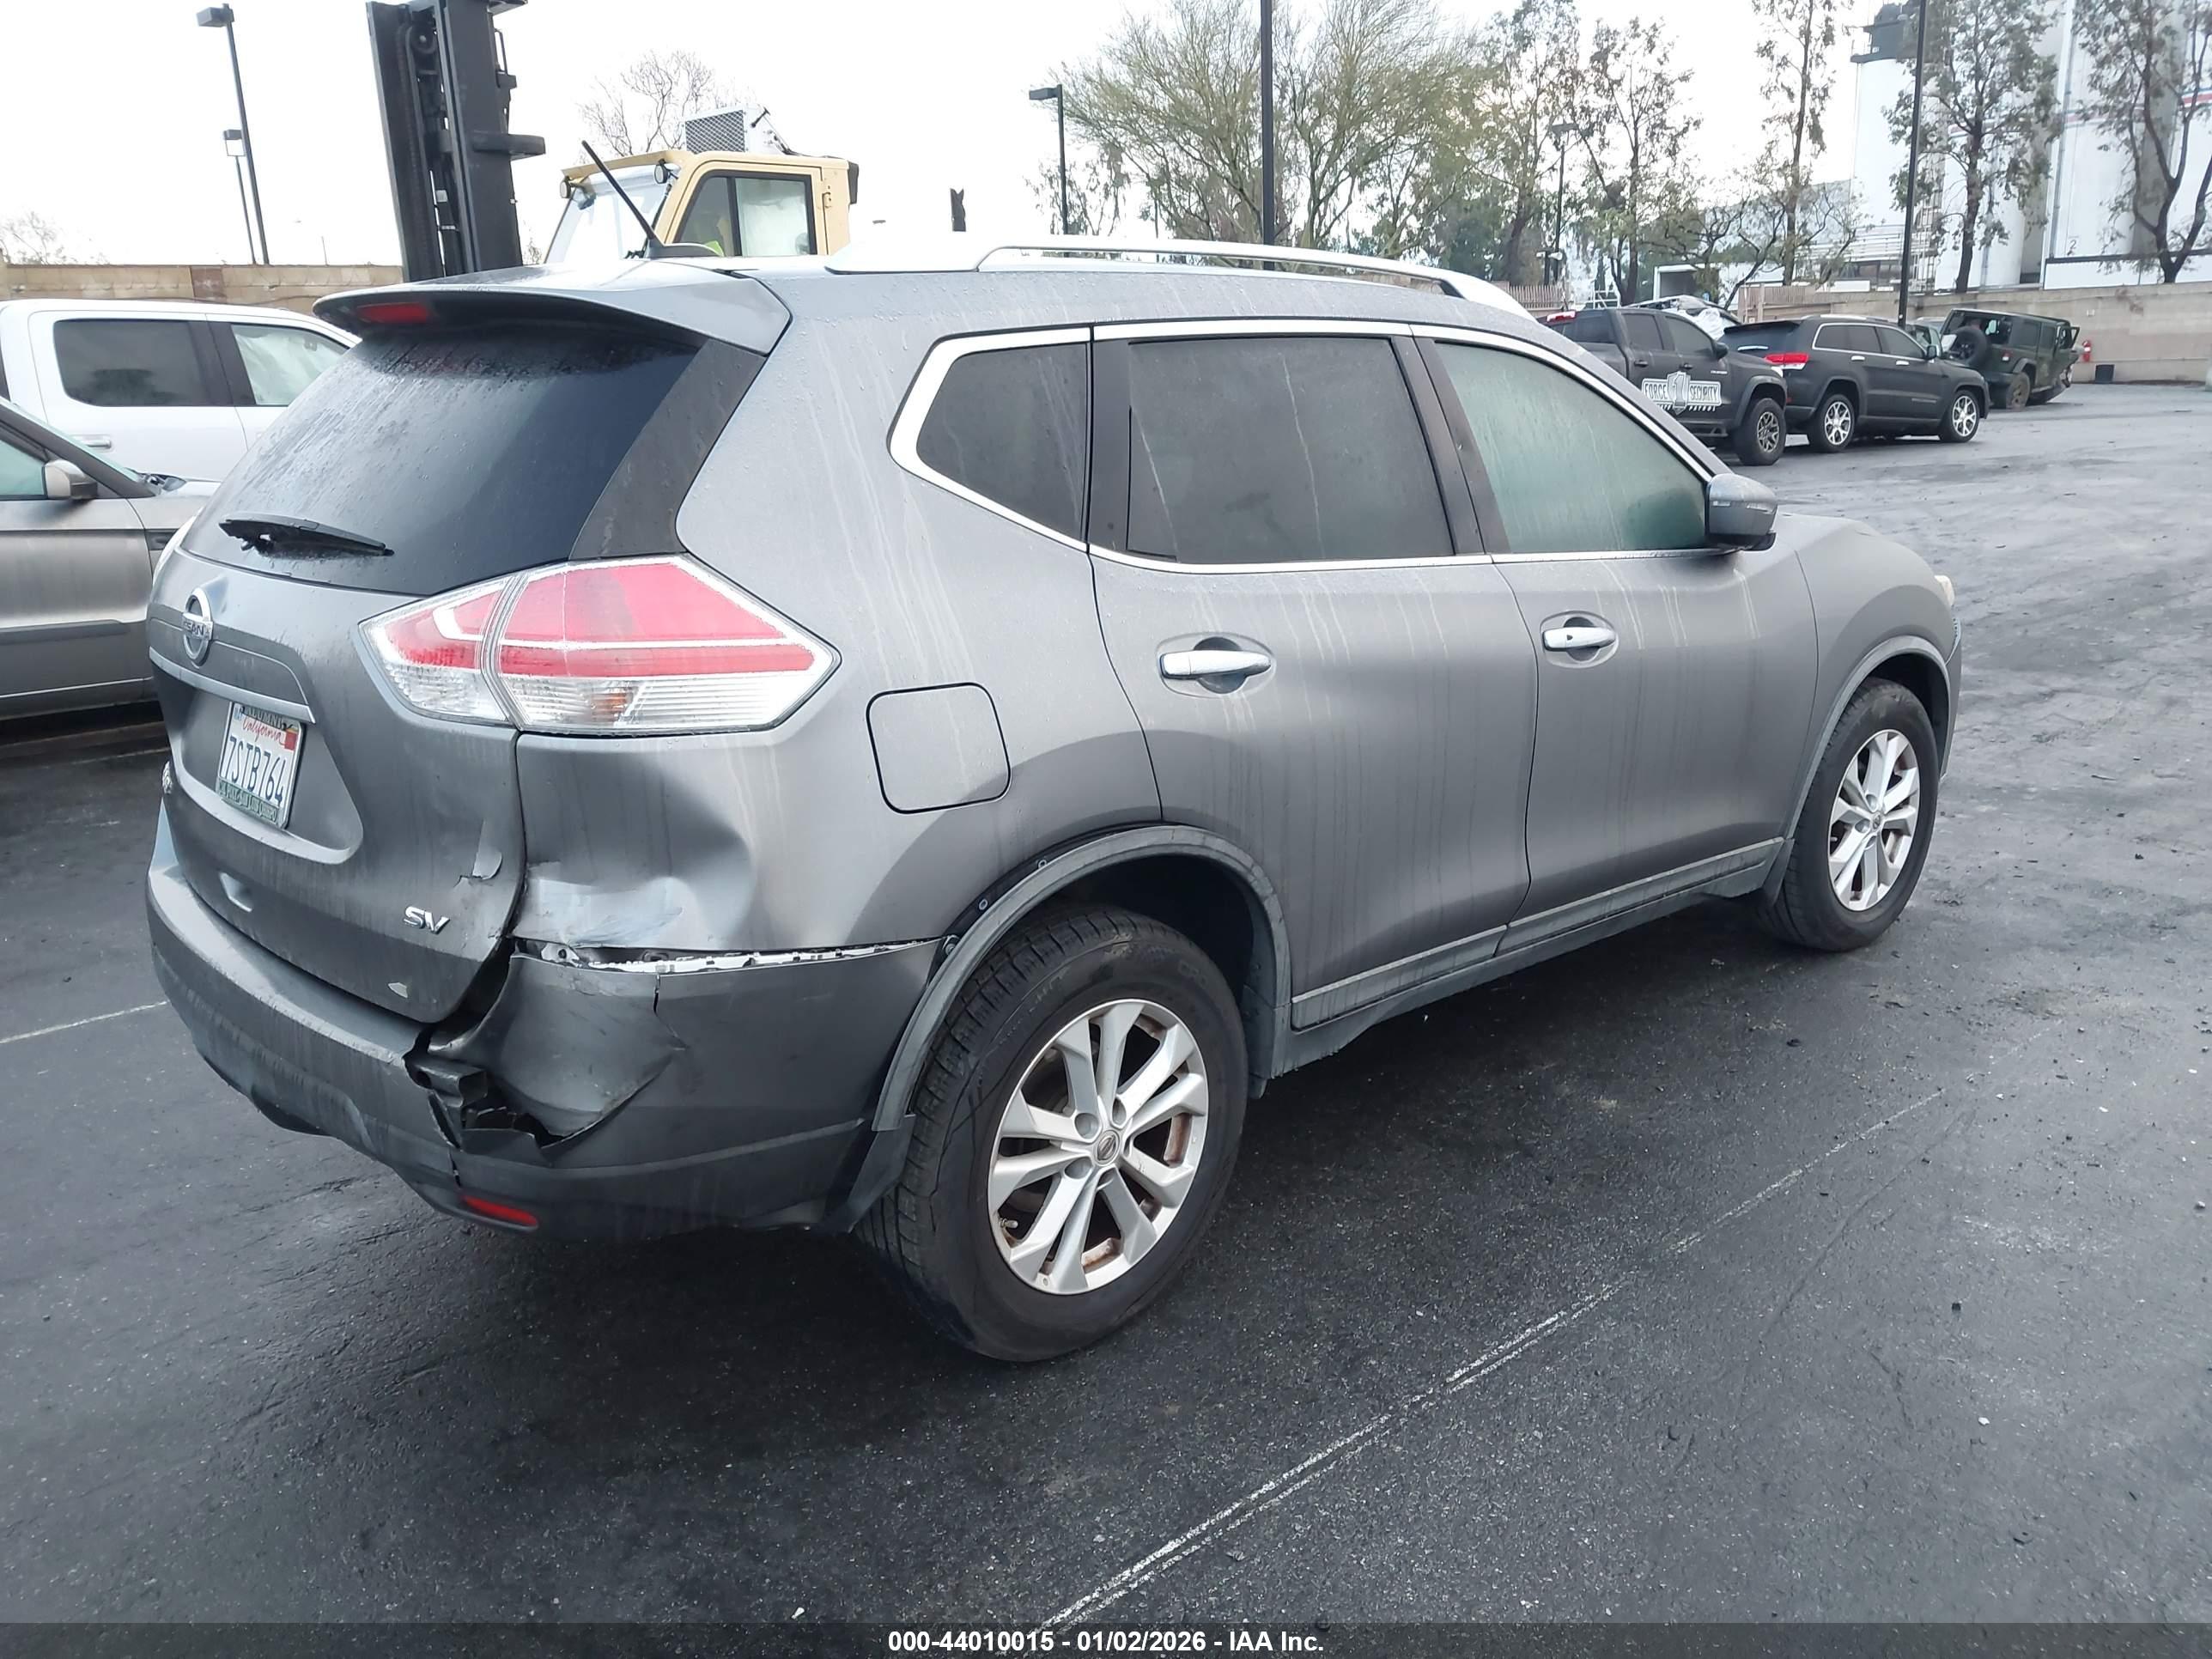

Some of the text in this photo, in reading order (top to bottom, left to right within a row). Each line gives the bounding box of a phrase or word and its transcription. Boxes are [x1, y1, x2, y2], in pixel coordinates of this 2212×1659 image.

[1644, 383, 1668, 400] FORCE
[1689, 385, 1718, 402] SECURITY
[243, 715, 284, 745] California
[225, 735, 286, 807] 7STB764
[404, 906, 450, 934] SV
